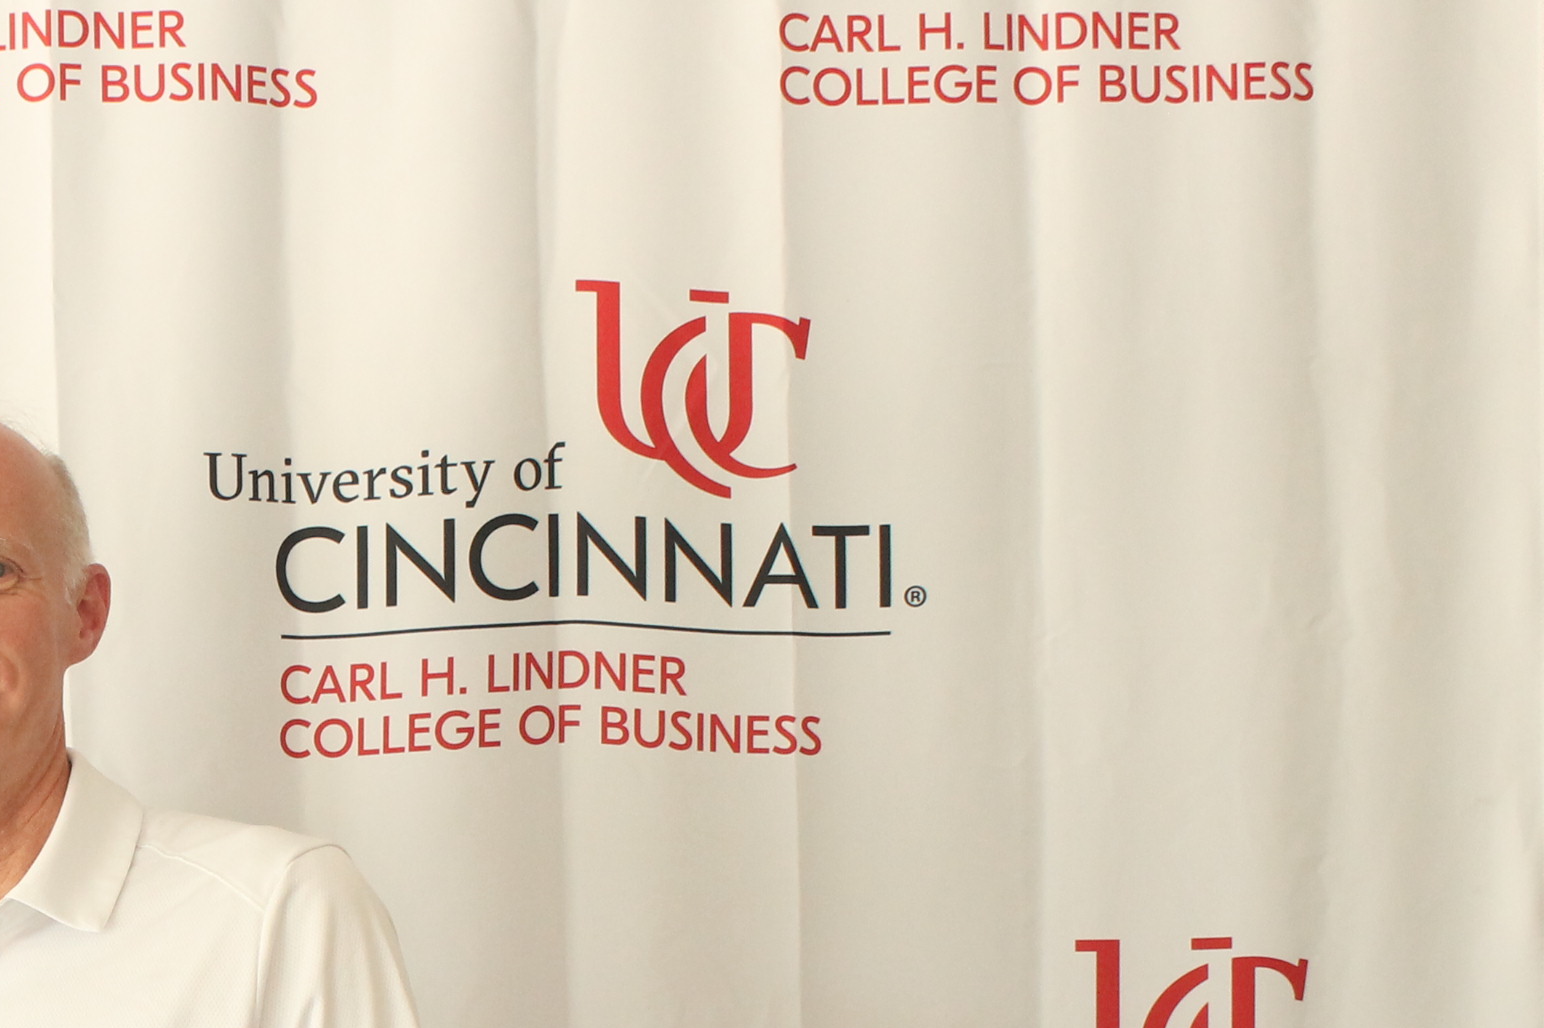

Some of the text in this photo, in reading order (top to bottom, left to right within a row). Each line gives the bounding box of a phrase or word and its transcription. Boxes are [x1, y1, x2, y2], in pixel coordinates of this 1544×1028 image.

[779, 11, 1182, 53] CARL H. LINDNER
[17, 62, 83, 104] OF
[101, 62, 318, 109] BUSINESS
[779, 61, 1314, 107] COLLEGE OF BUSINESS
[203, 442, 565, 508] University of
[280, 650, 687, 705] CARL H. LINDNER
[280, 704, 822, 759] COLLEGE OF BUSINESS
